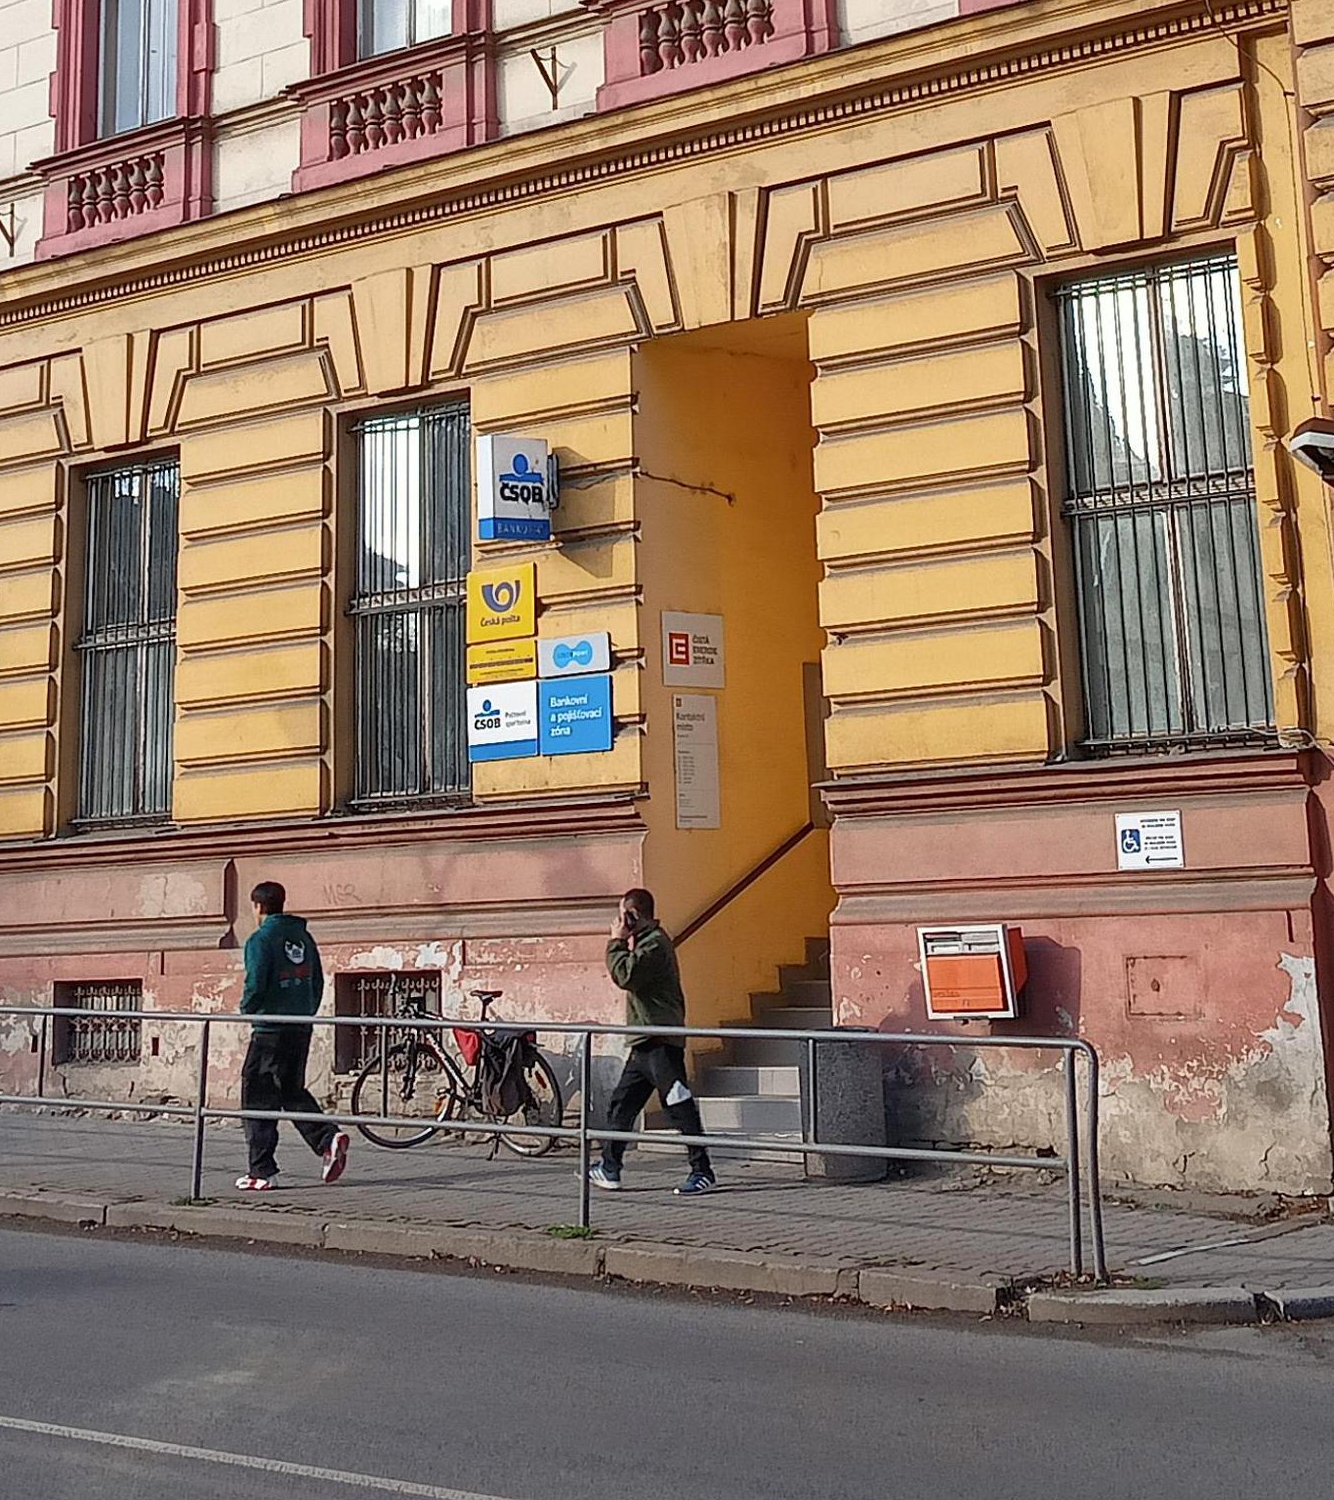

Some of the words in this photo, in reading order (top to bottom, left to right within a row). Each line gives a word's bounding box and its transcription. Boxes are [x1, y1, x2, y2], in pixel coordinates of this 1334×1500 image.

[549, 694, 588, 708] Bankovní
[550, 713, 556, 722] a
[550, 725, 571, 736] zóna
